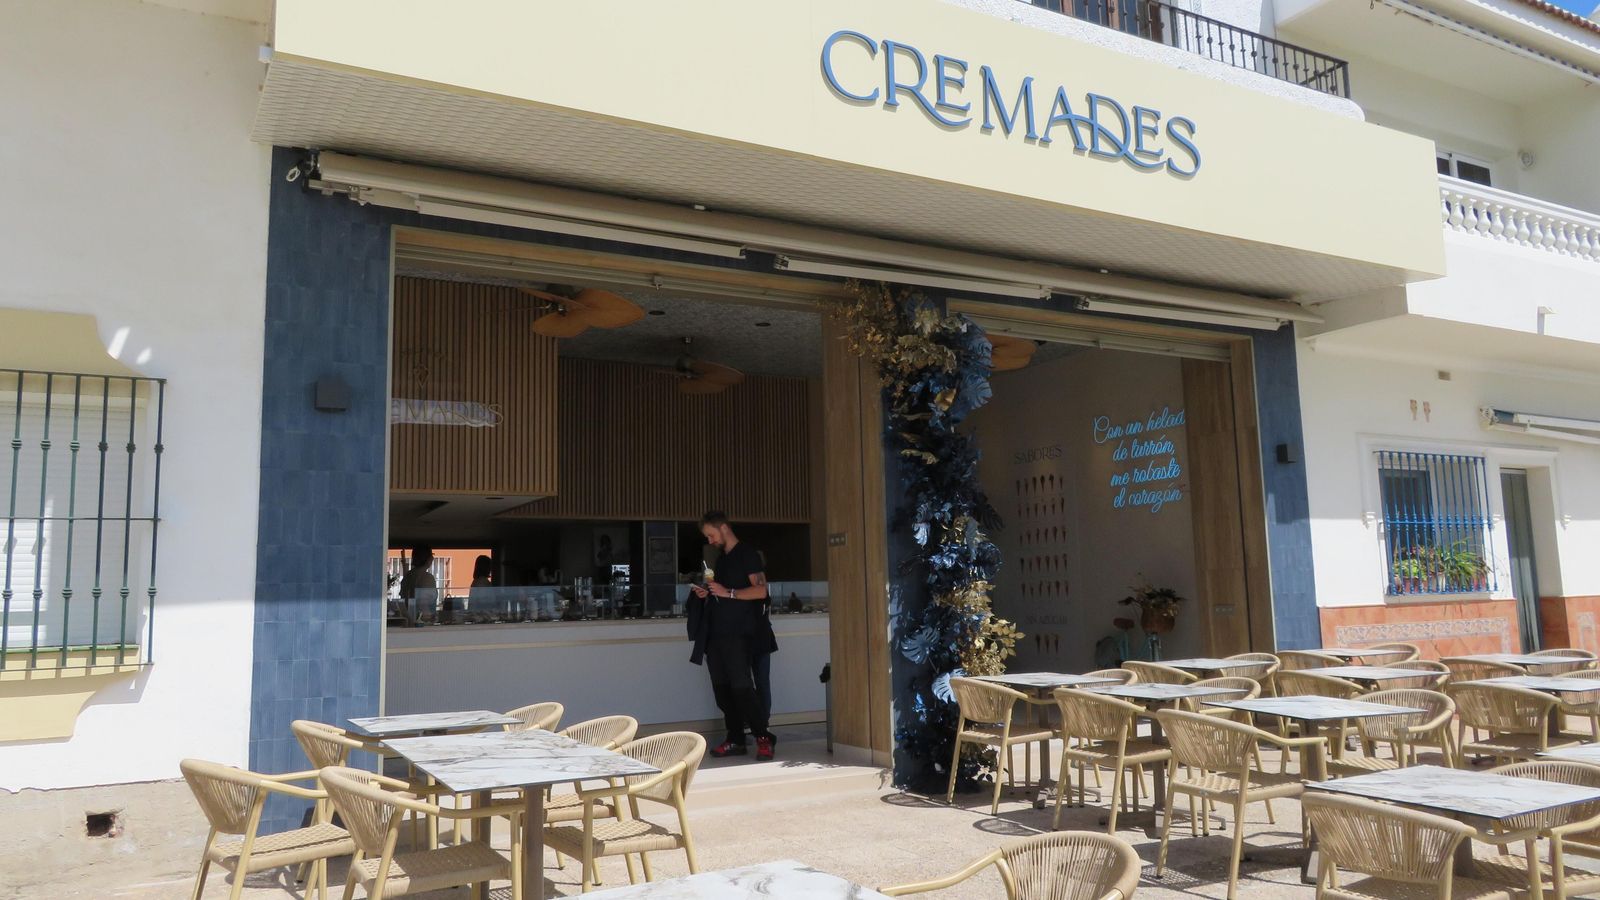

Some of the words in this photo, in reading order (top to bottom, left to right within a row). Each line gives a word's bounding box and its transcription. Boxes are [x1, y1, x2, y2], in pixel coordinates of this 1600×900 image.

[820, 30, 1201, 177] CREMADES
[1093, 416, 1123, 443] Con
[1125, 421, 1143, 436] un
[1147, 406, 1185, 432] helad
[1014, 447, 1062, 464] SABORES
[1113, 440, 1128, 461] de
[1110, 472, 1129, 487] me
[1132, 457, 1180, 483] robaste
[1113, 487, 1126, 508] el
[1129, 482, 1181, 512] corazón
